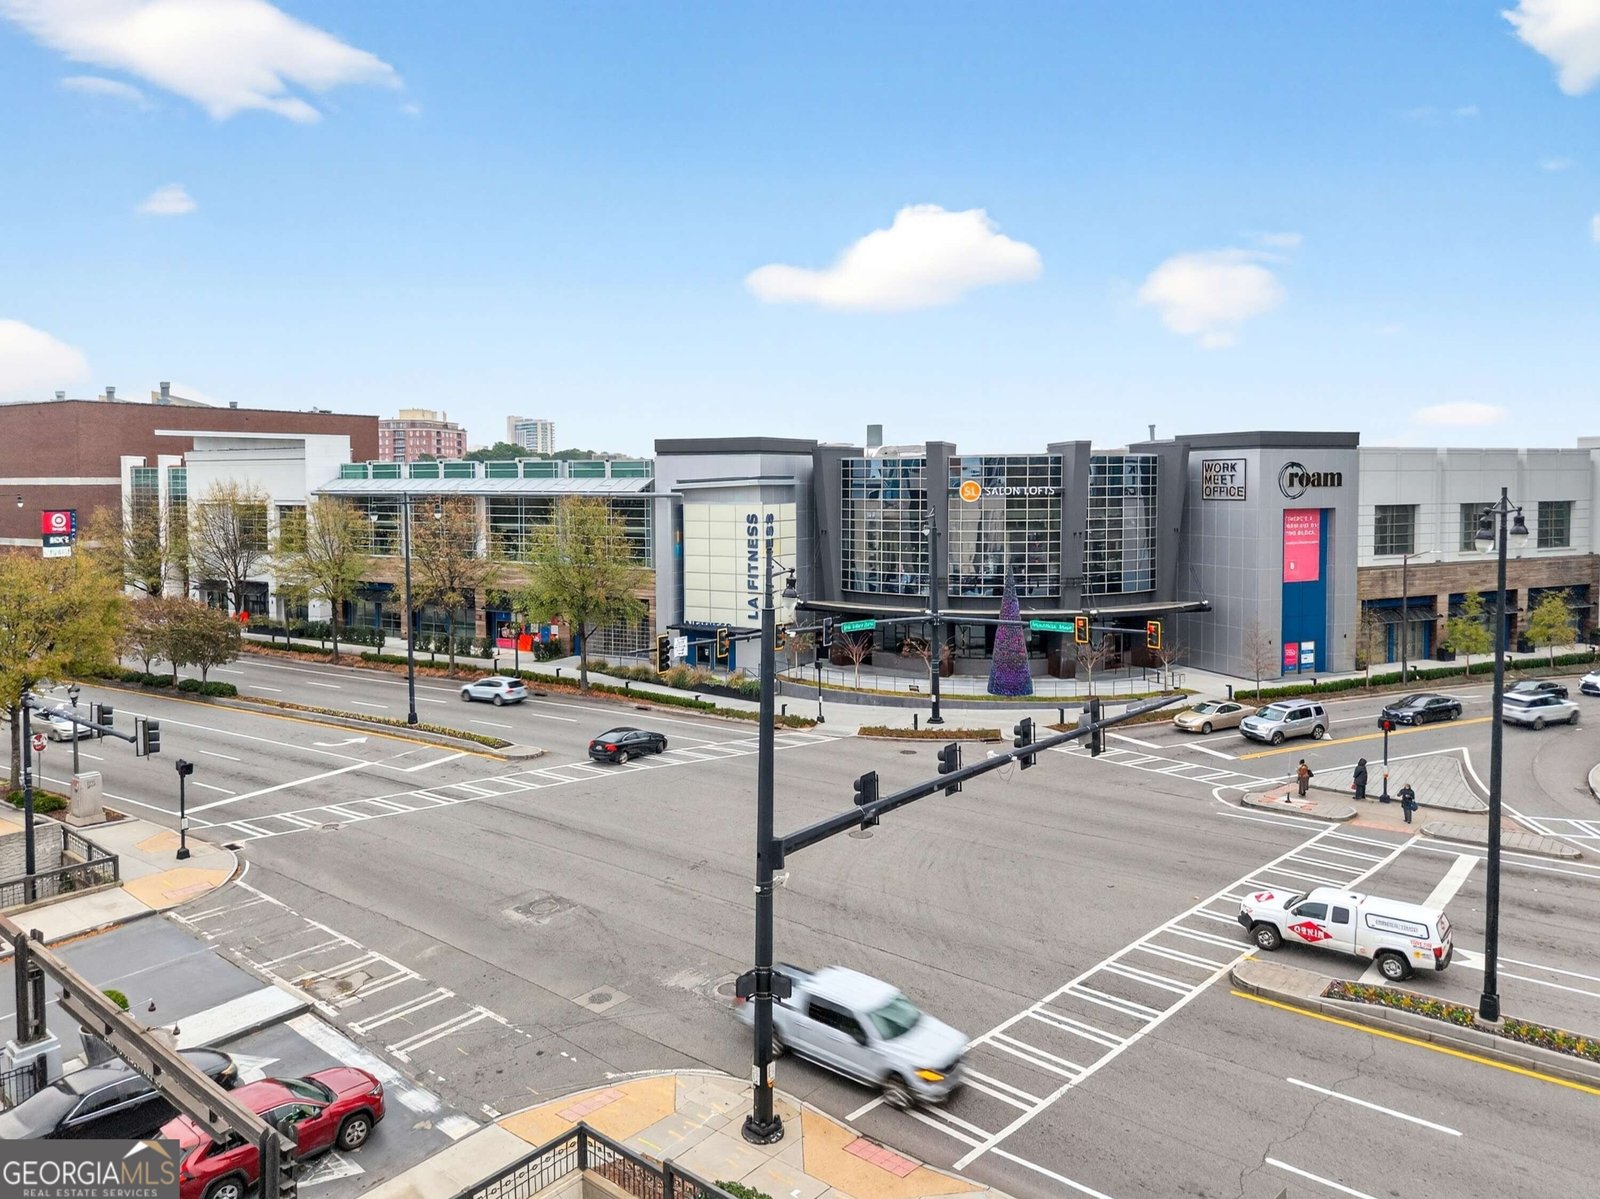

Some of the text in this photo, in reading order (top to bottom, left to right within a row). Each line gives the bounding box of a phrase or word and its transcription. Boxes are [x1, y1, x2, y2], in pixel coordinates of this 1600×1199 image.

[1204, 462, 1237, 473] WORK
[1204, 474, 1235, 485] MEET
[1288, 471, 1342, 488] roam
[985, 486, 1020, 496] SALON
[1024, 486, 1055, 495] LOFTS
[1204, 486, 1245, 497] OFFICE
[746, 513, 759, 620] LA FITNESS
